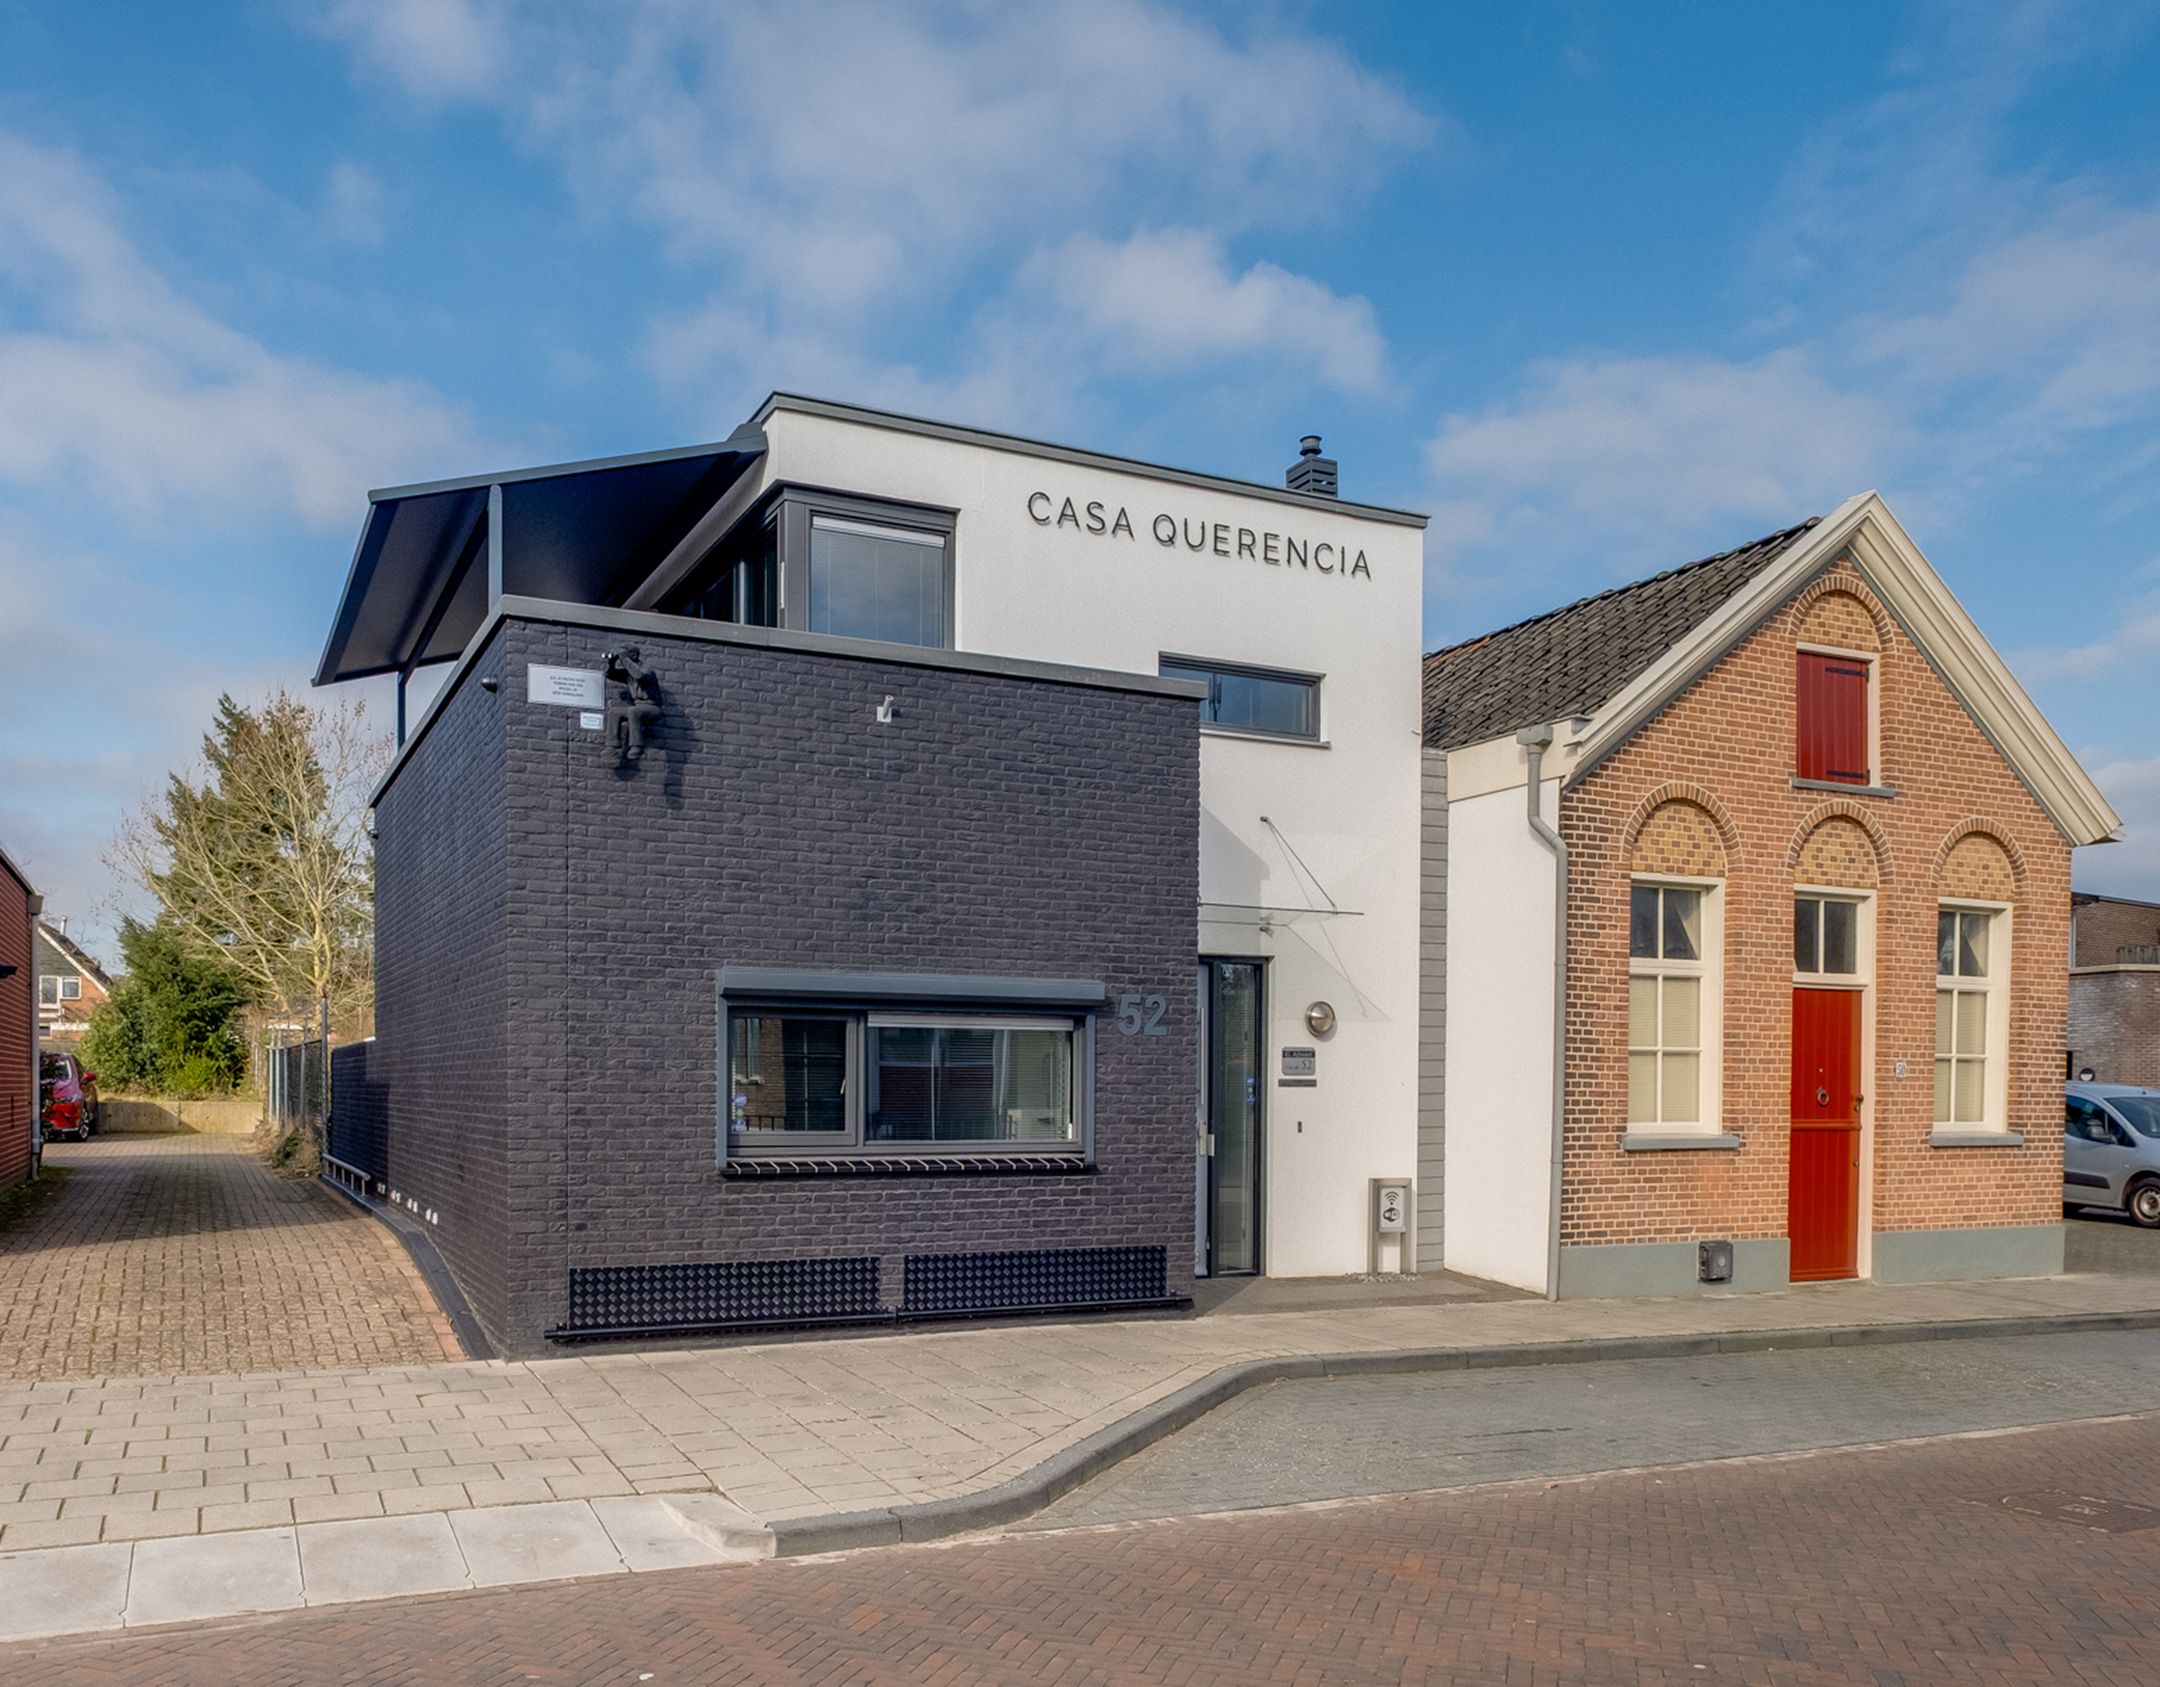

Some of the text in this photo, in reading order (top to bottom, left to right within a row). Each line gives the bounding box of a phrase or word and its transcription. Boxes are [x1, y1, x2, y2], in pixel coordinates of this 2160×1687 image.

[1027, 491, 1372, 580] CASA QUERENCIA
[1119, 993, 1168, 1036] 52
[1302, 1059, 1312, 1071] 52
